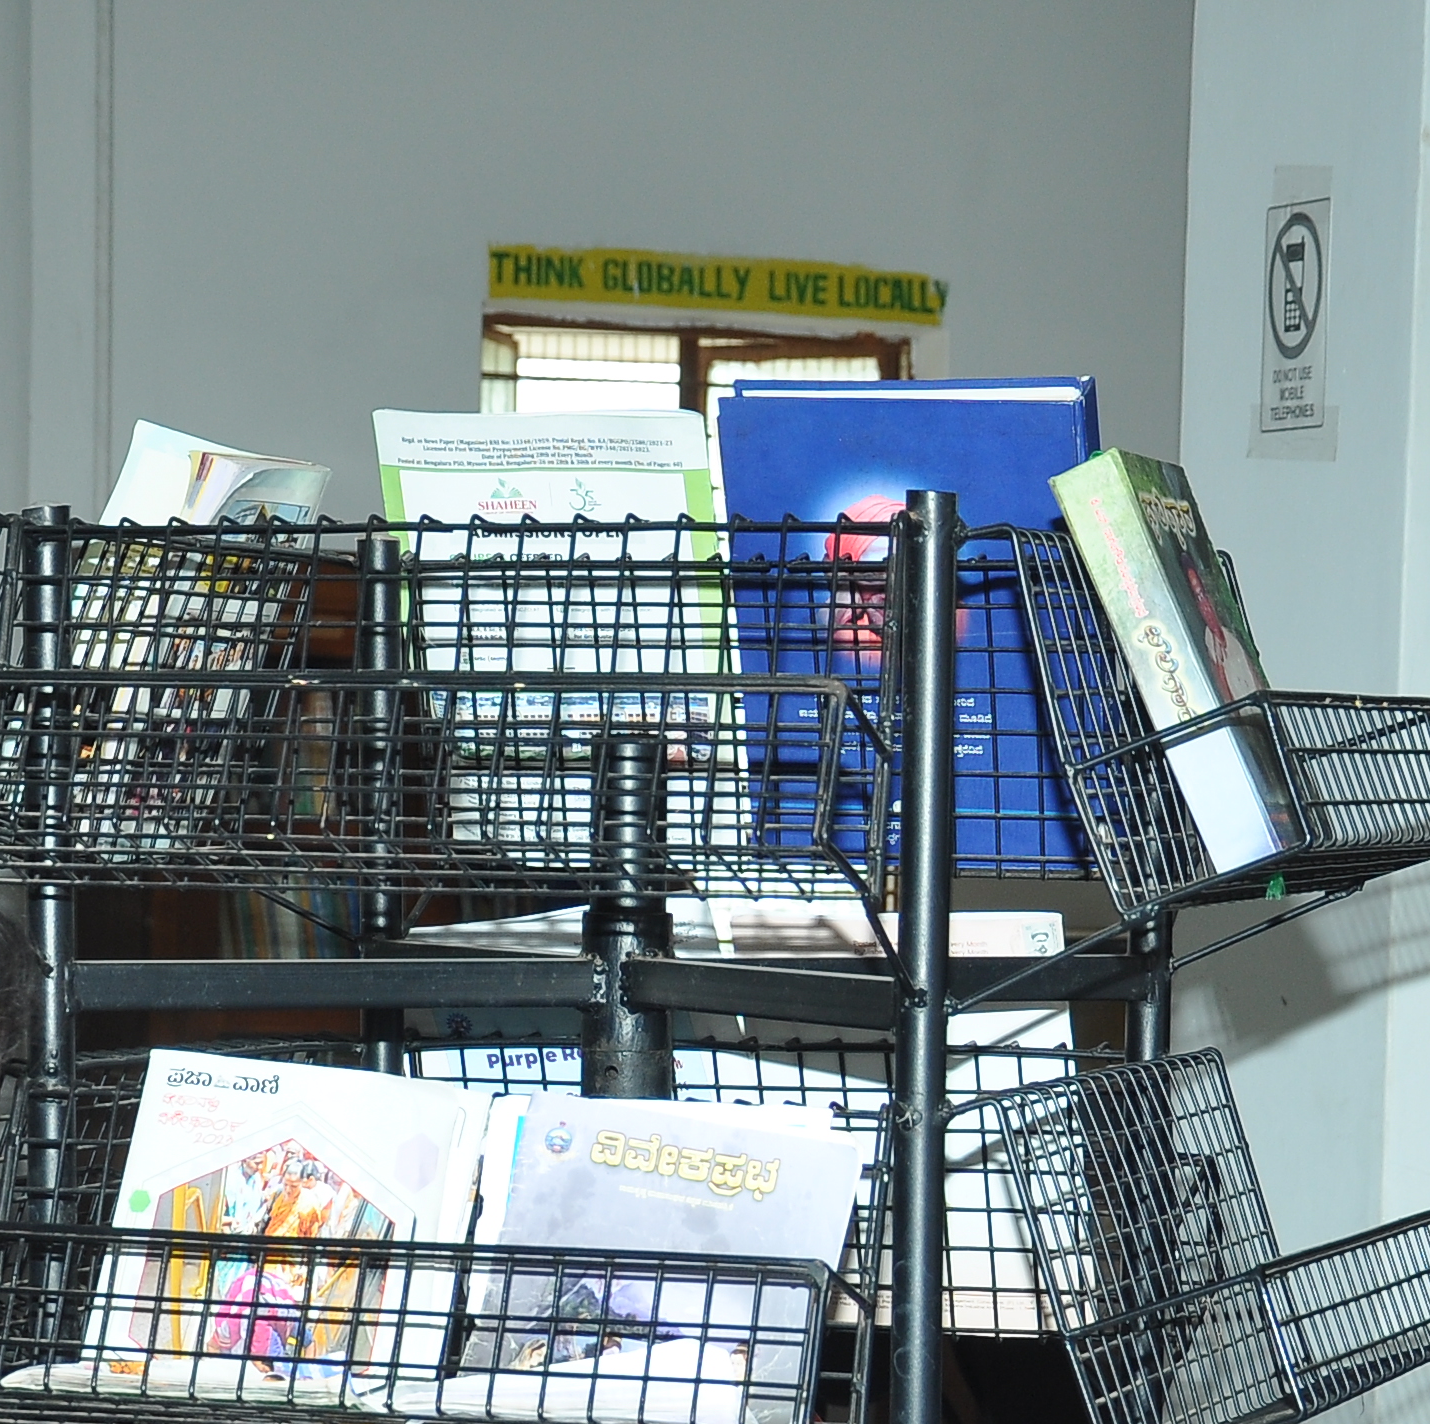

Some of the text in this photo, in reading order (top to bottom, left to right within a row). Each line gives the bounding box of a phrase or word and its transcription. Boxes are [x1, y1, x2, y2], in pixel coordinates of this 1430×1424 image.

[490, 251, 950, 315] THINK GLOBALLY LIVE LOCALLY
[1273, 365, 1313, 384] DO NOT USE
[1279, 385, 1305, 401] MOBILE
[1270, 403, 1315, 421] TELEPHONES
[439, 438, 455, 446] Paper
[478, 499, 538, 512] SHAHEEN
[486, 1048, 557, 1069] Purpe
